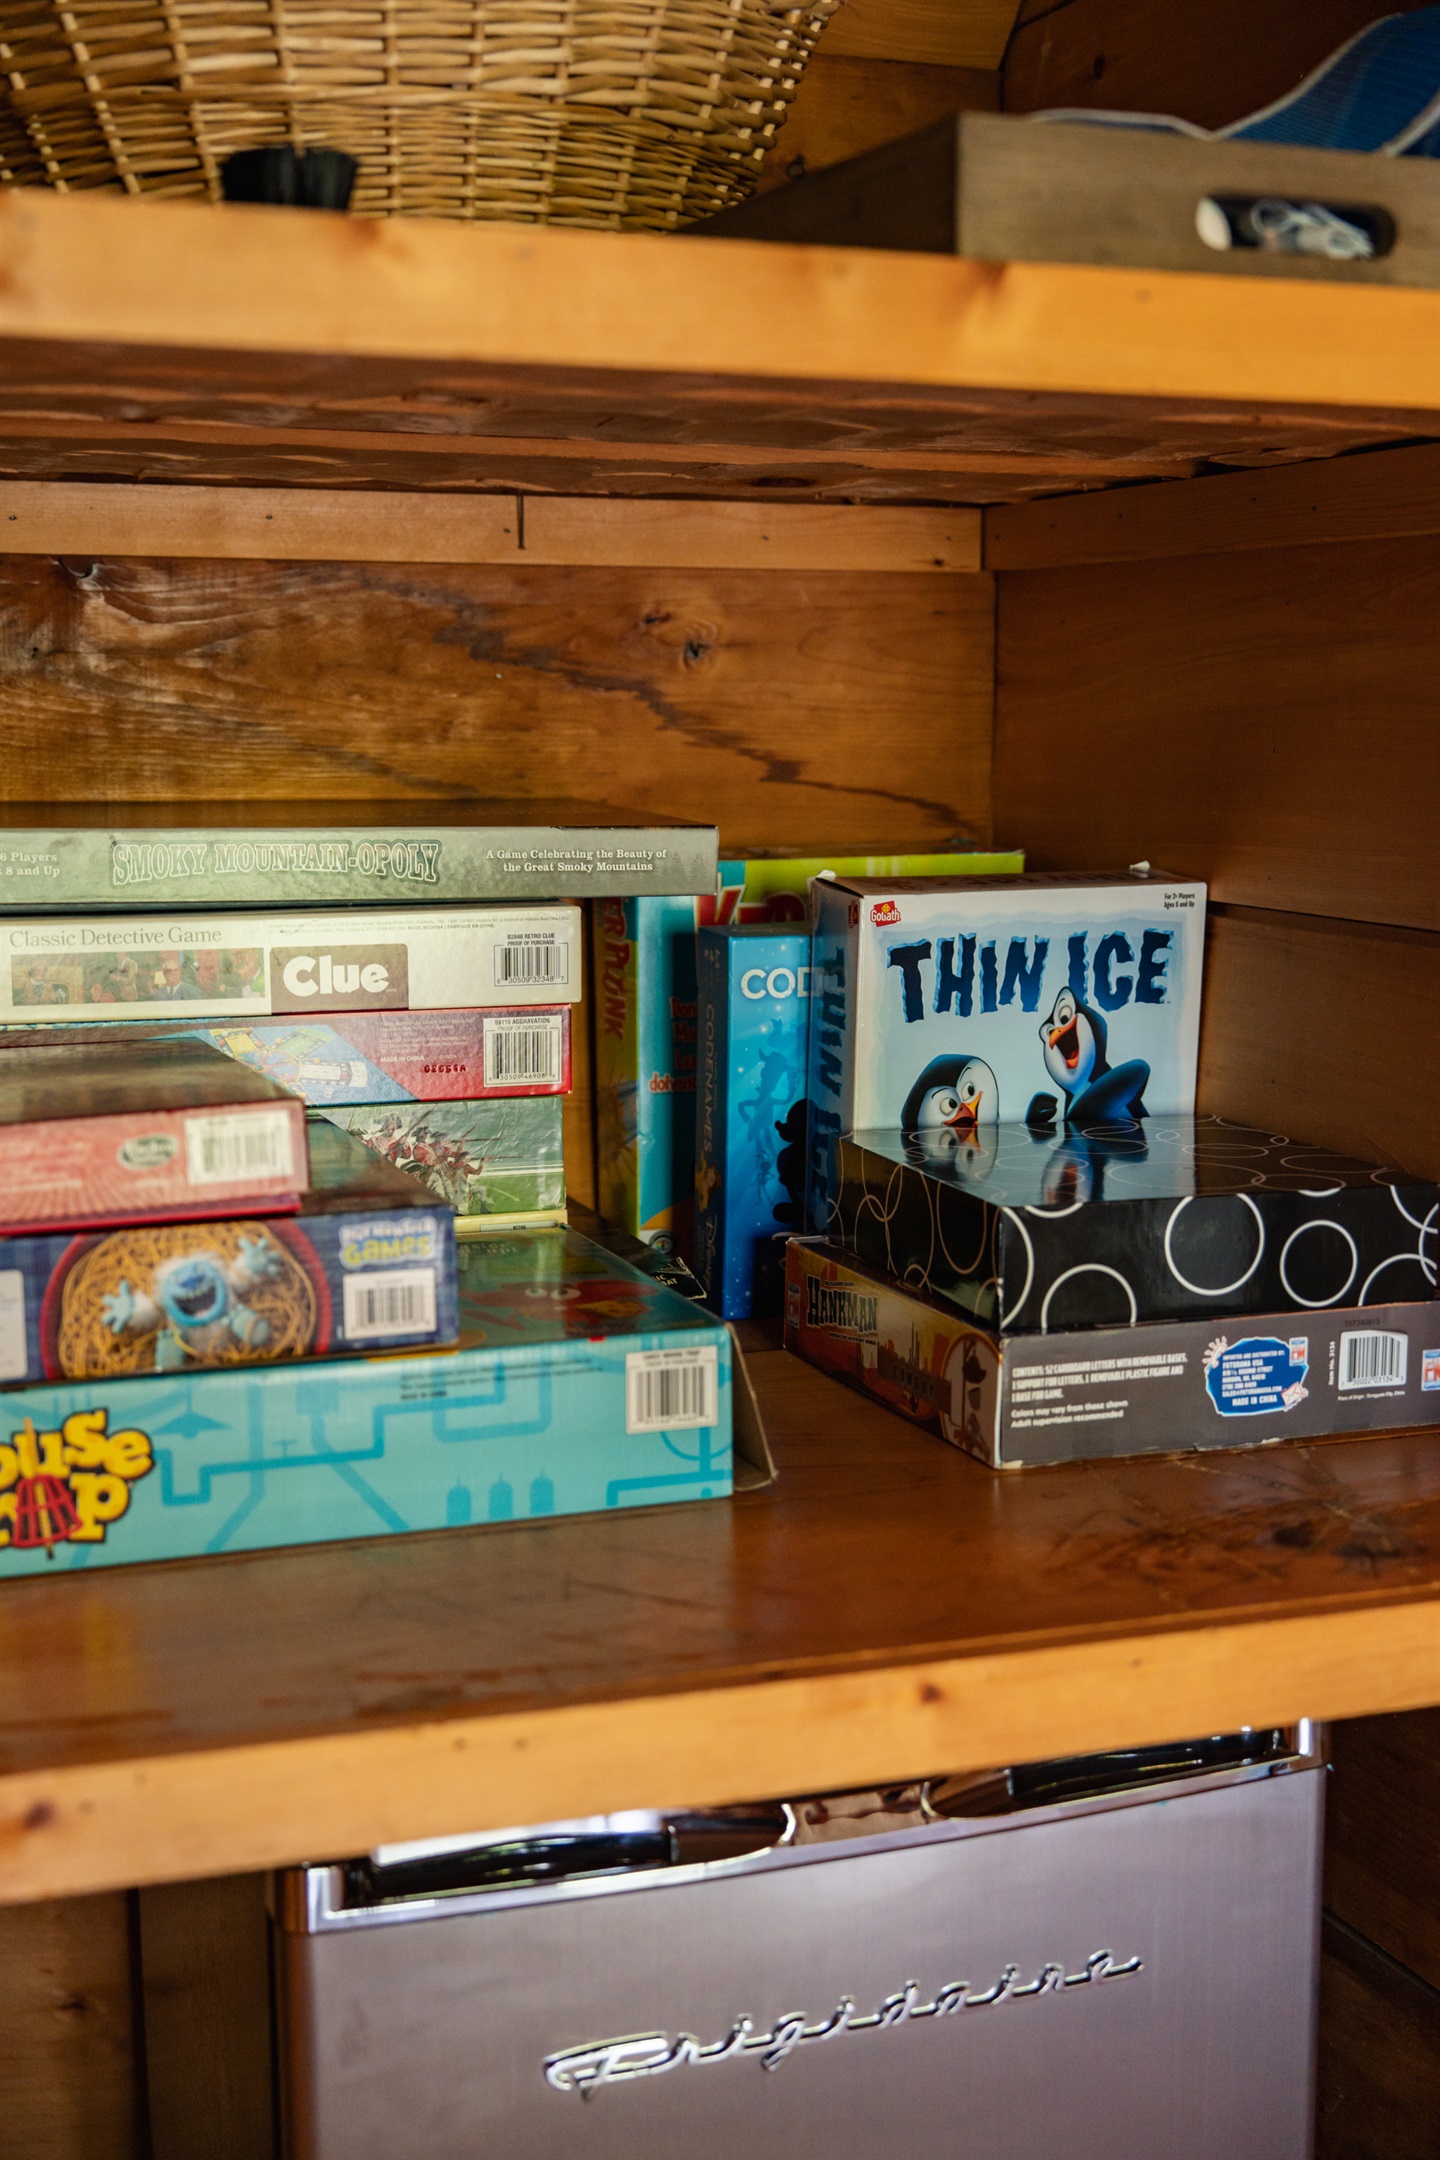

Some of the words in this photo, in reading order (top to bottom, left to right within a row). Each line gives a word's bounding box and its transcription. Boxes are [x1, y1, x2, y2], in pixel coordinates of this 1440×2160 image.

[11, 852, 58, 864] Players
[486, 851, 494, 859] A
[497, 850, 528, 859] Game
[530, 849, 593, 860] Celebrating
[596, 849, 613, 859] the
[616, 849, 653, 860] Beauty
[656, 848, 667, 858] of
[5, 866, 13, 876] 8
[17, 865, 40, 876] and
[43, 865, 60, 878] Up
[112, 842, 208, 885] SMOKY
[214, 841, 439, 883] MOUNTAIN-OPOLY
[503, 862, 521, 872] the
[524, 862, 554, 872] Great
[557, 862, 593, 873] Smoky
[596, 861, 653, 871] Mountains
[1178, 892, 1195, 900] Players
[1164, 901, 1175, 910] Ages
[10, 929, 76, 947] Classic
[81, 926, 164, 946] Detective
[168, 927, 222, 944] Game
[283, 955, 389, 997] Clue
[507, 976, 530, 984] 30509
[532, 975, 554, 983] 32348
[887, 931, 1051, 1024] THIN
[1066, 927, 1175, 1013] ICE
[512, 1017, 550, 1025] AGGRAVATION
[702, 1003, 716, 1153] CODENAMES
[807, 1275, 878, 1334] HANKMAN
[1091, 1359, 1116, 1371] LETTERS
[1116, 1357, 1132, 1368] WITH
[1132, 1354, 1167, 1366] REMOVABLE
[1090, 1370, 1125, 1383] REMOVABLE
[1125, 1368, 1149, 1379] PLASTIC
[1149, 1366, 1170, 1378] FIGURE
[1170, 1364, 1184, 1375] AND
[1232, 1397, 1249, 1406] MADE
[1250, 1396, 1258, 1405] IN
[1259, 1394, 1277, 1404] CHINA
[1011, 1409, 1034, 1418] Colors
[1035, 1408, 1050, 1417] may
[1051, 1407, 1065, 1415] vary
[1067, 1404, 1084, 1412] from
[1085, 1402, 1105, 1410] those
[1106, 1400, 1128, 1409] shown
[1010, 1419, 1031, 1428] Adult
[1032, 1415, 1073, 1427] supervision
[1074, 1410, 1124, 1421] recommended
